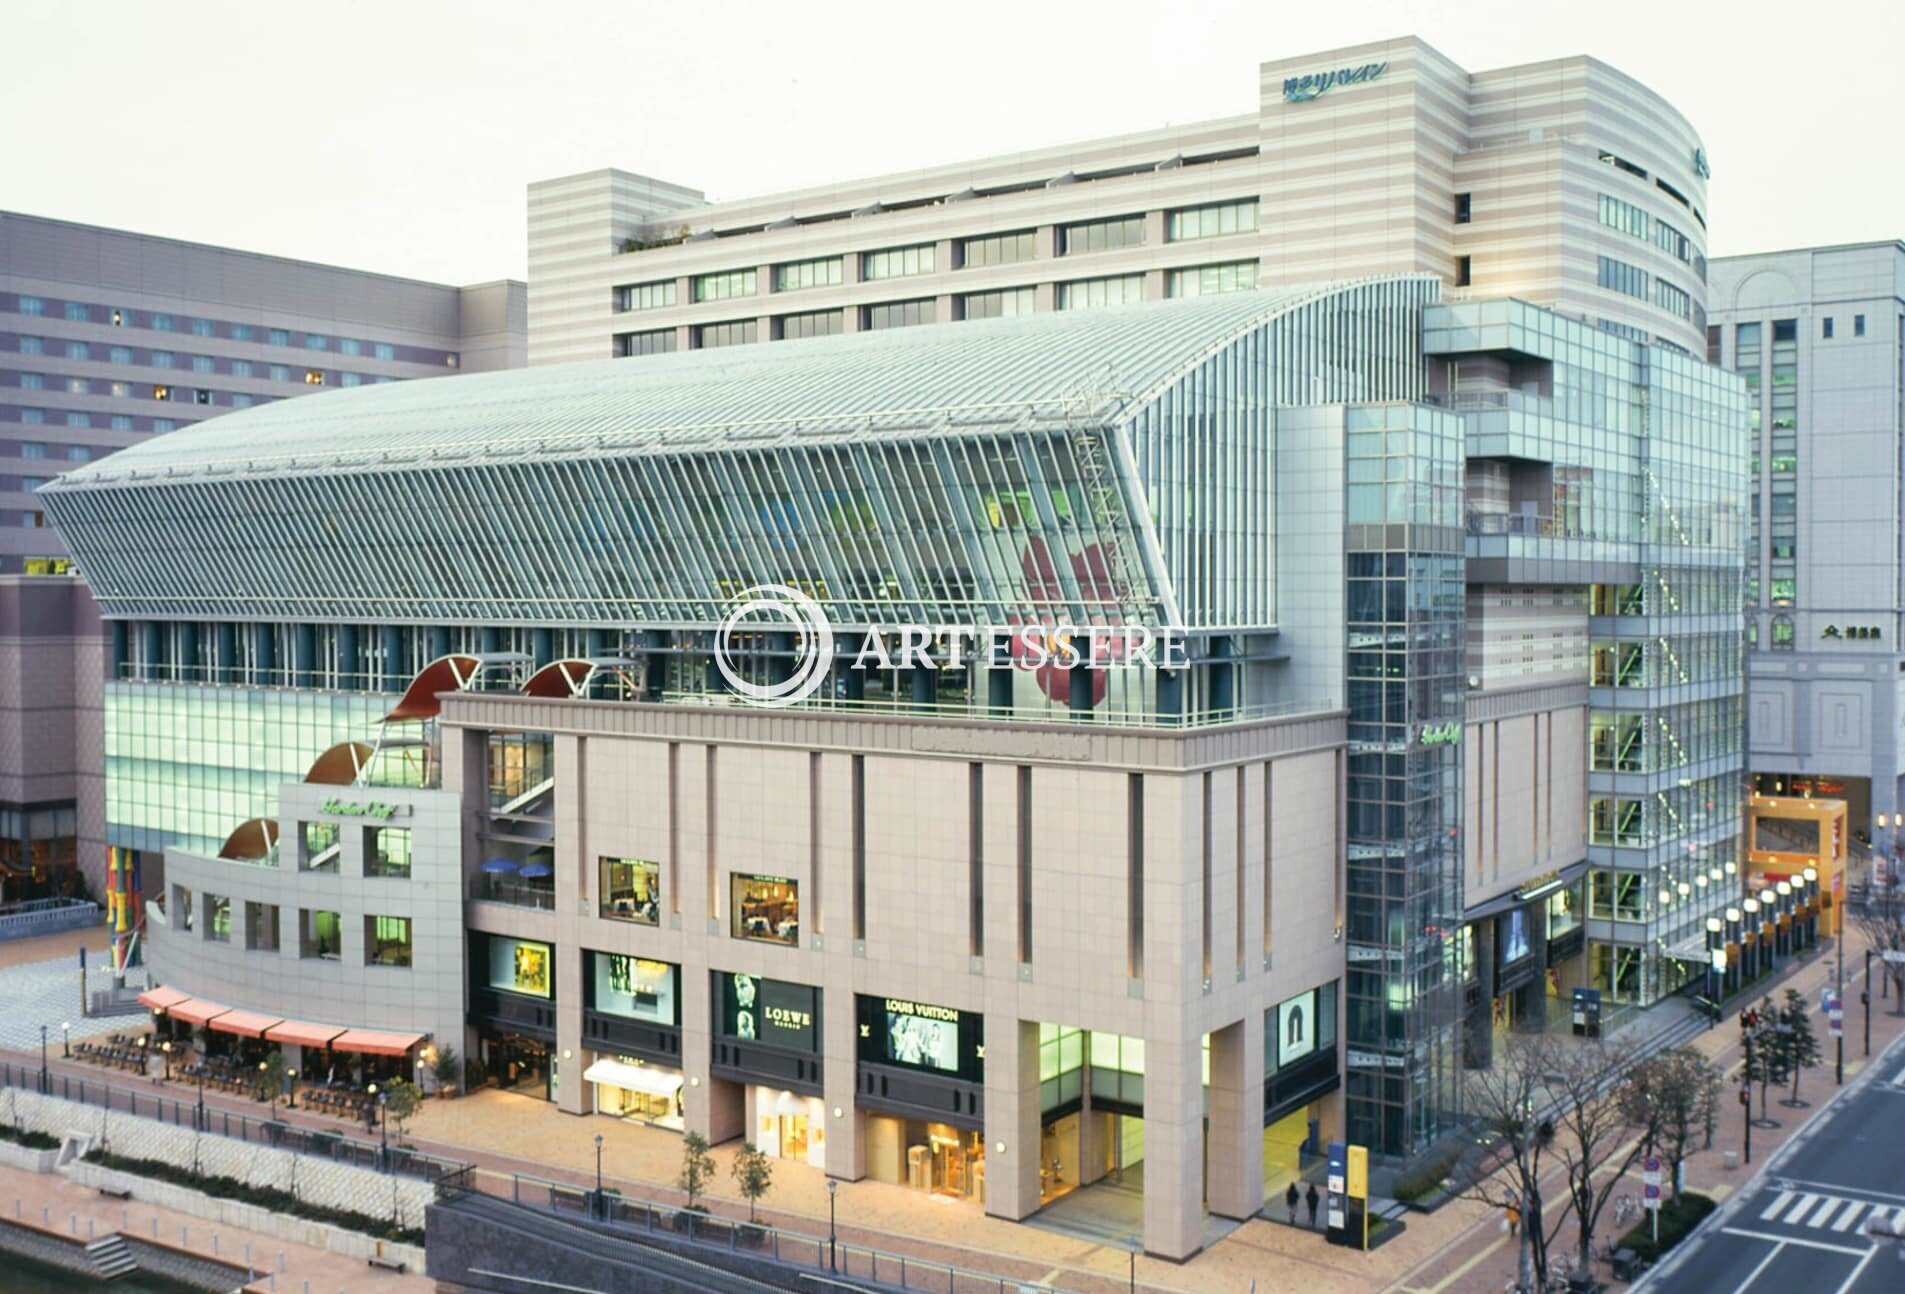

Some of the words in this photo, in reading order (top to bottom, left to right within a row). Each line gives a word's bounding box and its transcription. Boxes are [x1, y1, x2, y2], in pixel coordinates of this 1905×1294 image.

[765, 1006, 810, 1026] LOEWE
[886, 999, 914, 1014] LOUIS
[915, 1004, 959, 1021] VUITTON
